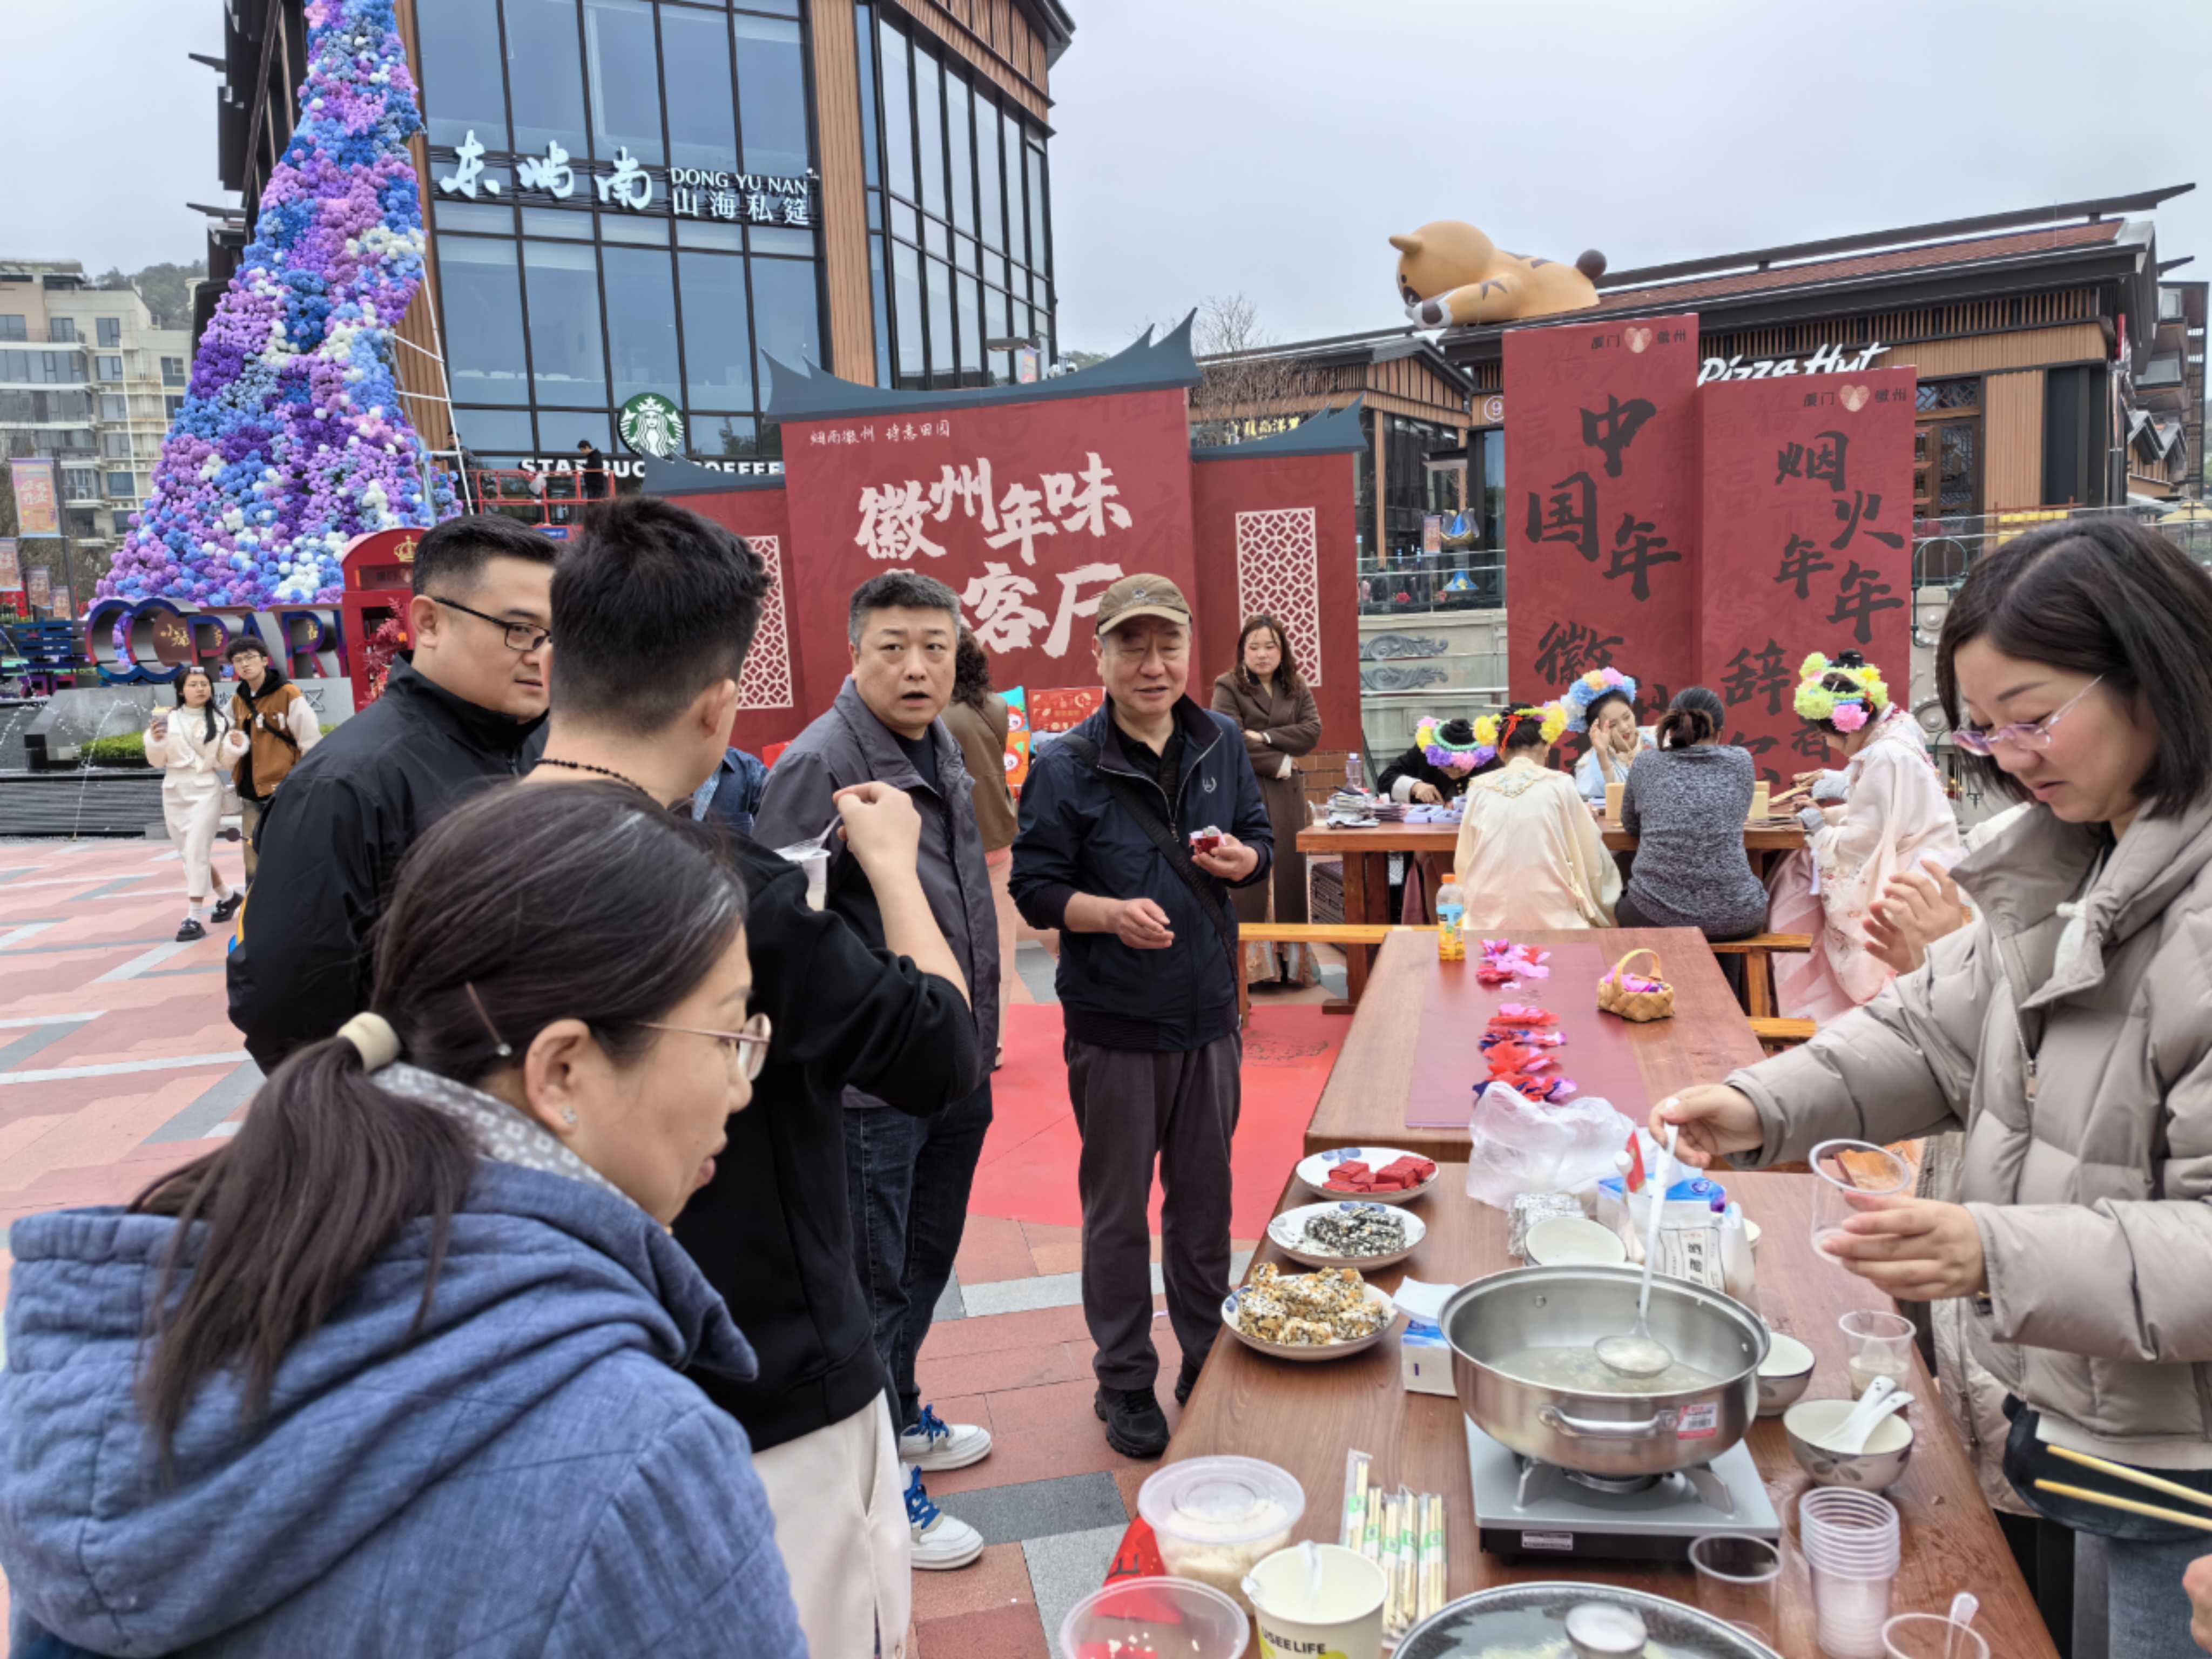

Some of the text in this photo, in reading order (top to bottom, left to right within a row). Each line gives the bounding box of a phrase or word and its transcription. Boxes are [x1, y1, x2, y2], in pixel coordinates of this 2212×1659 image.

[671, 167, 807, 195] DONG YU NAN
[673, 188, 810, 225] 山海私筵
[1591, 334, 1621, 350] 厦门
[1697, 342, 1892, 387] Pizza Hut
[1804, 388, 1835, 407] 厦门
[854, 451, 1133, 567] 徽州年味
